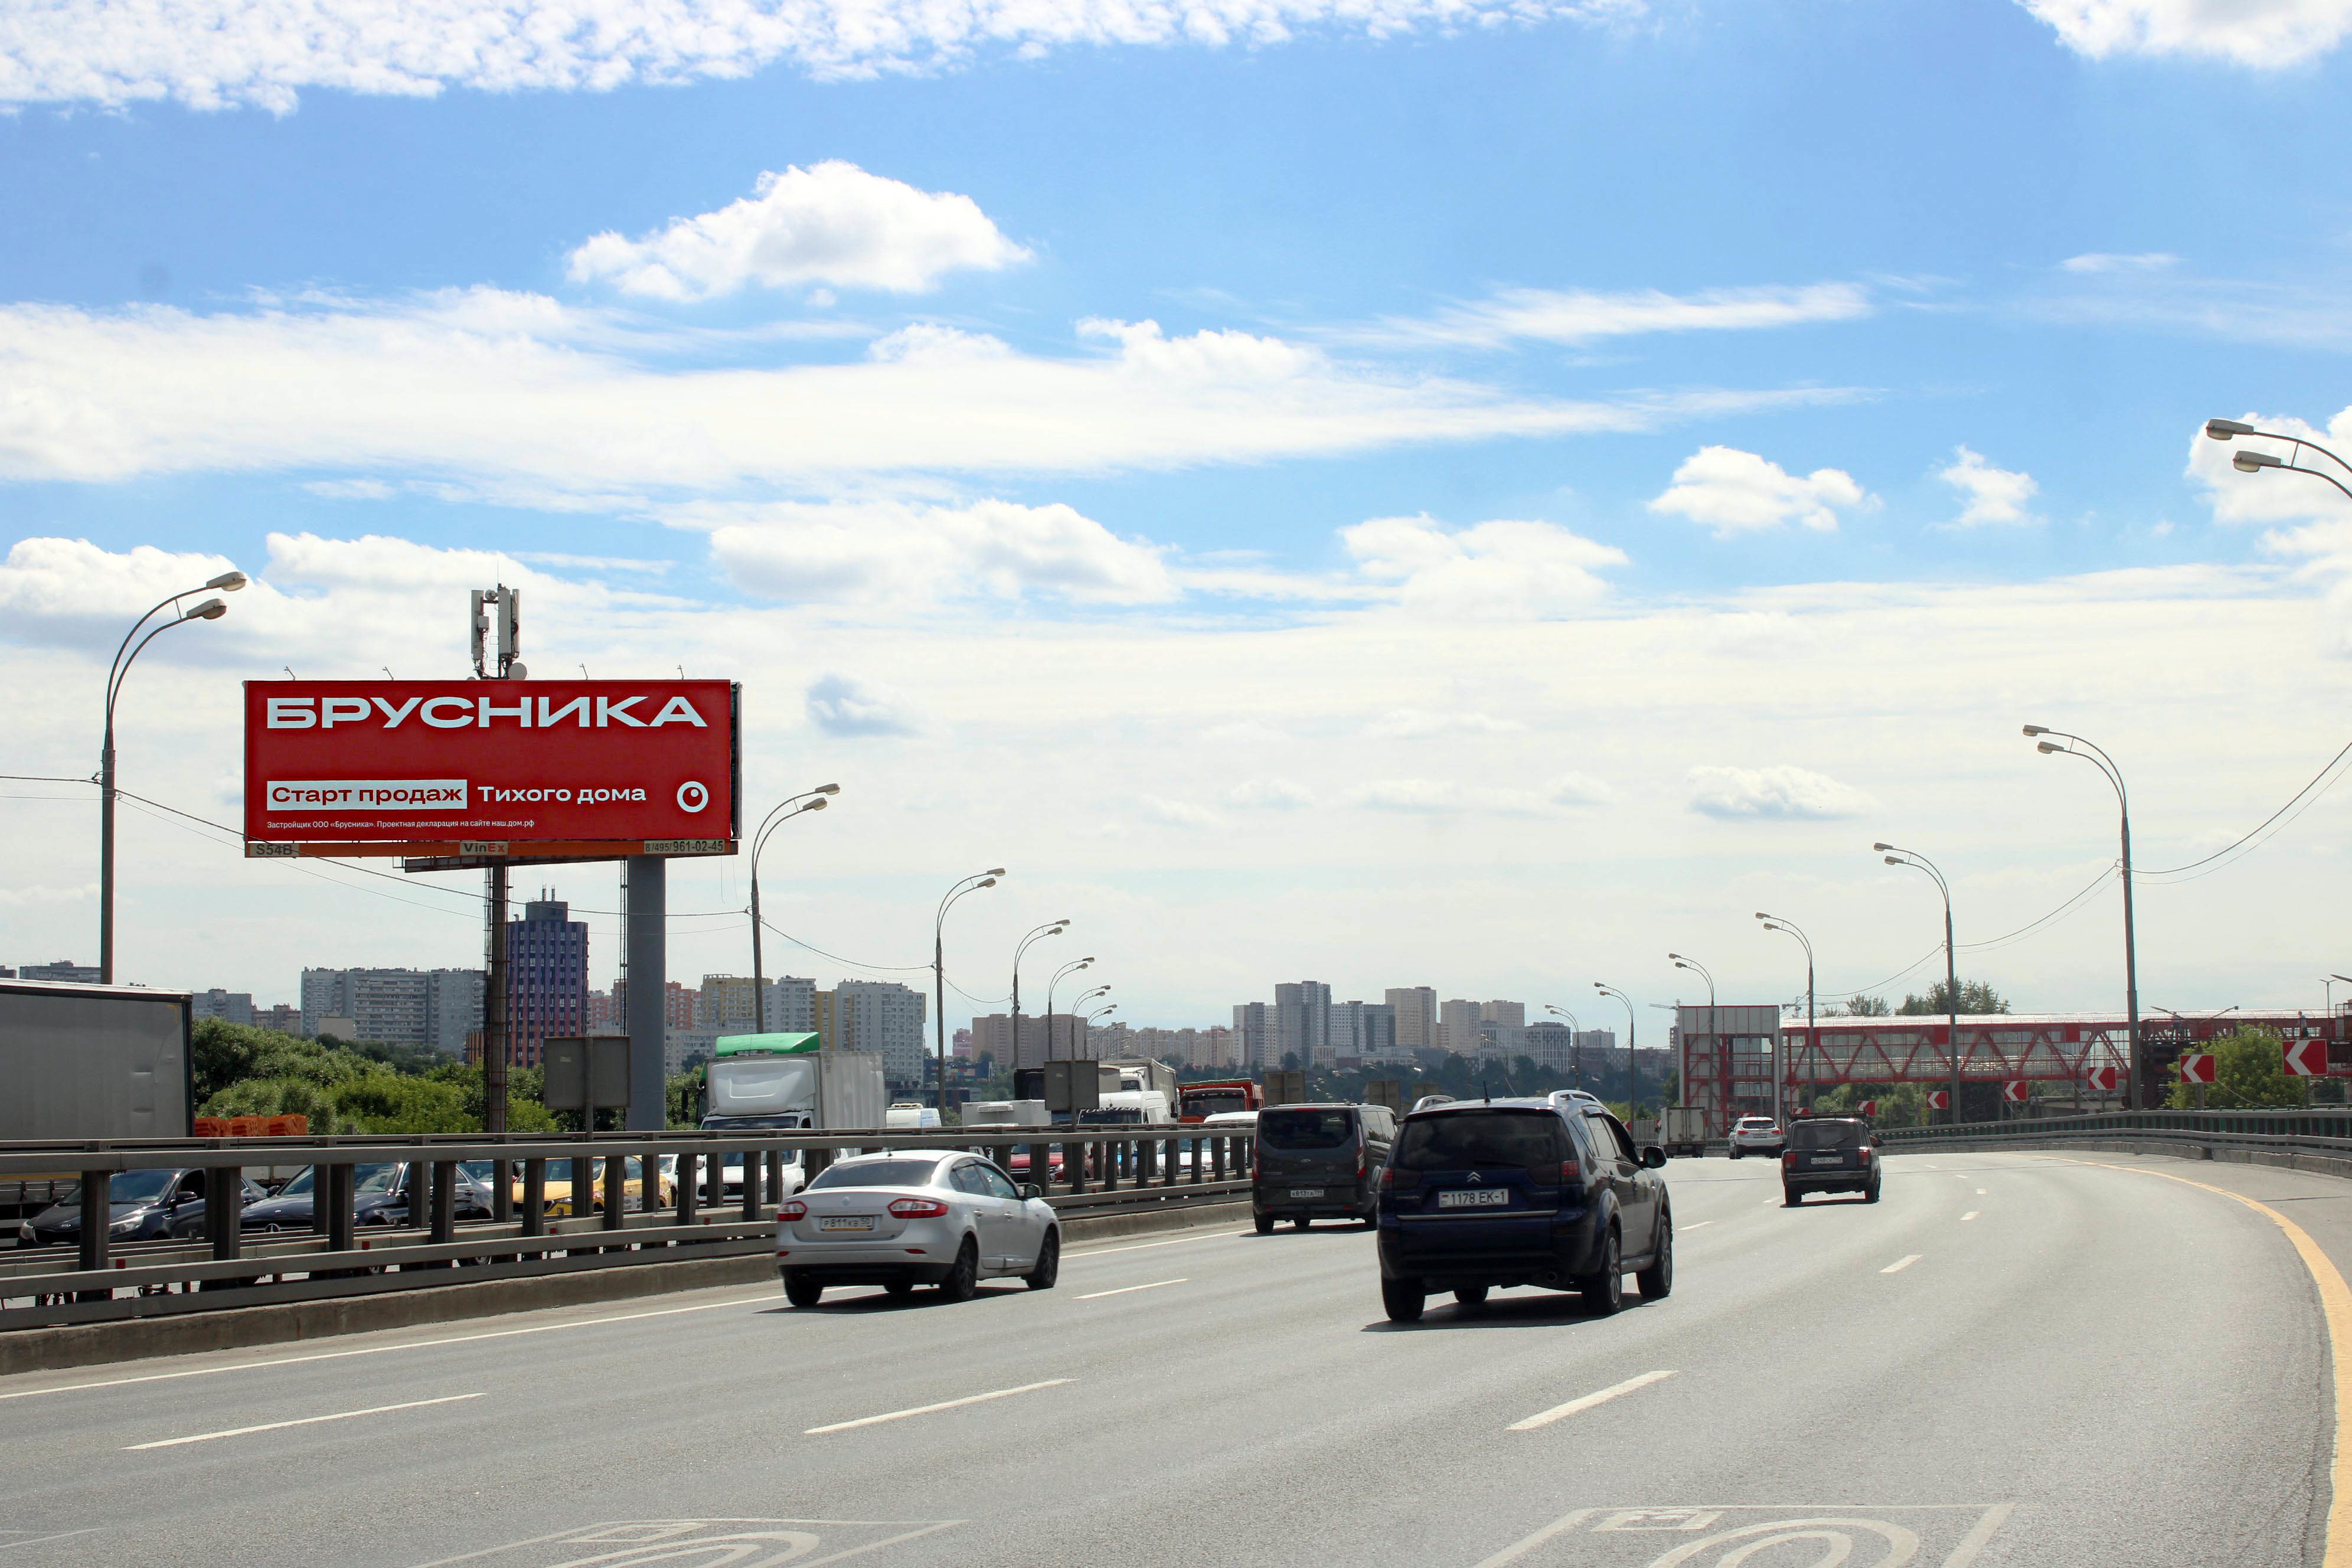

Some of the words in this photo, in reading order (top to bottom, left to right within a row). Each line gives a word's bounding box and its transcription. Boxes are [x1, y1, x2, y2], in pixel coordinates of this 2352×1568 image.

[267, 697, 708, 729] БРУСНИКА
[272, 787, 352, 806] Старт
[359, 789, 463, 806] продаж
[477, 786, 571, 802] Тихого
[577, 788, 646, 805] дома
[267, 821, 312, 829] Застройщик
[330, 821, 375, 829] «Брусника».
[377, 820, 415, 829] Проектная
[416, 820, 459, 828] декларация
[492, 819, 535, 828] наш.дом.рф
[256, 844, 292, 855] S54B
[464, 842, 505, 852] VinEx
[673, 840, 724, 852] 961-02-45
[1451, 1193, 1475, 1205] 1178
[1479, 1191, 1505, 1204] EK-1
